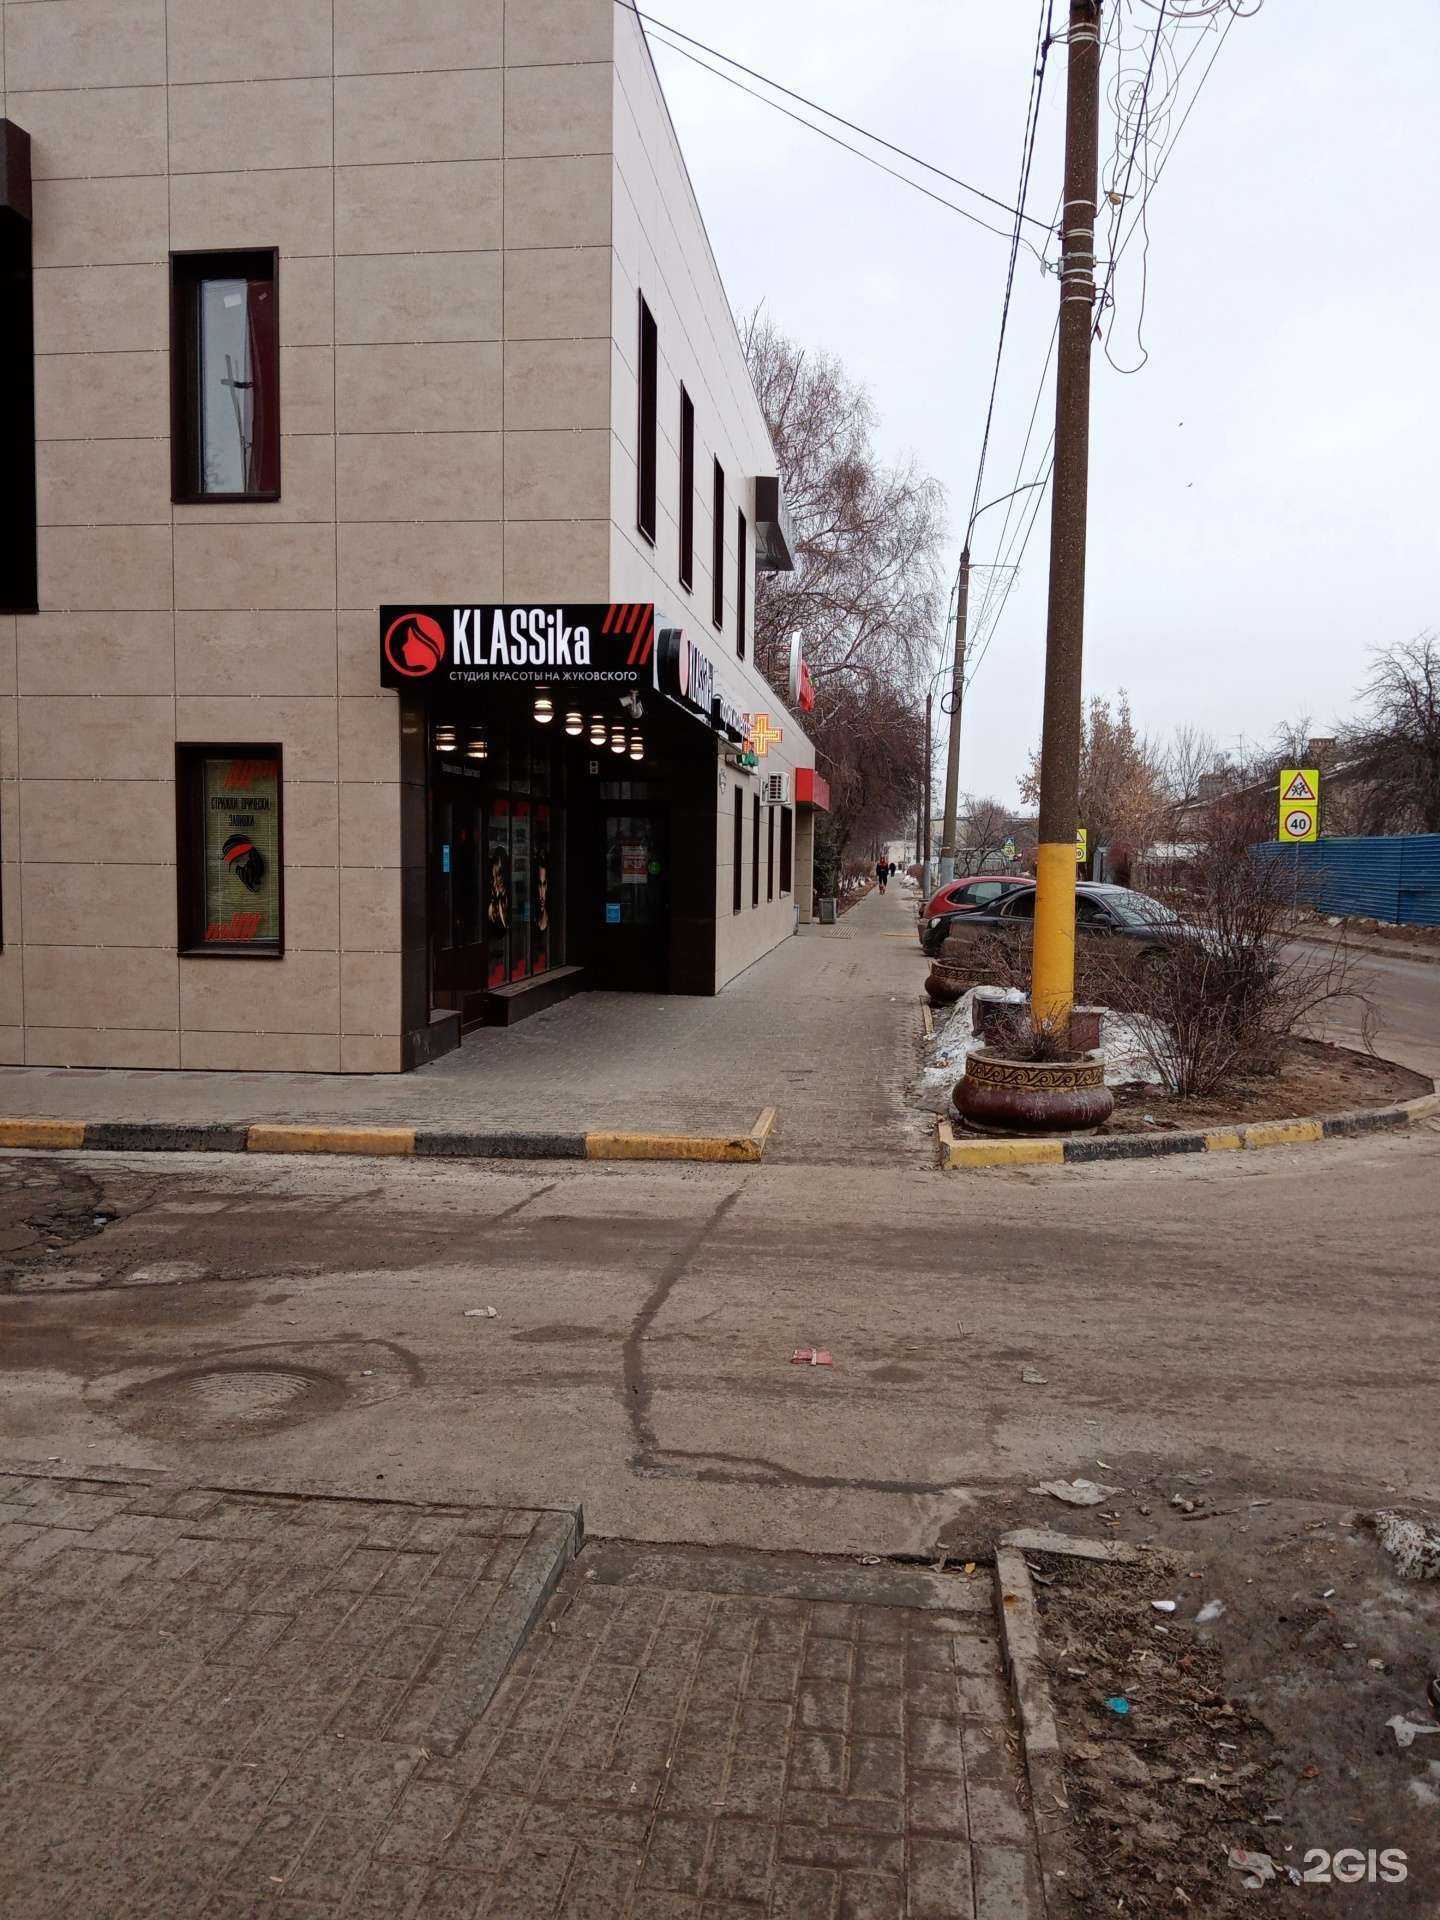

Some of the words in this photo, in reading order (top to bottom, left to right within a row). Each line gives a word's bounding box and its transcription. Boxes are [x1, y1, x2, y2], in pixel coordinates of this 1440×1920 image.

[453, 609, 591, 665] KLASSika
[449, 671, 490, 682] СТУДИЯ
[492, 671, 543, 681] КРАСОТЫ
[545, 671, 560, 681] НА
[562, 671, 638, 681] ЖУКОВСКОГО
[1290, 819, 1307, 830] 40
